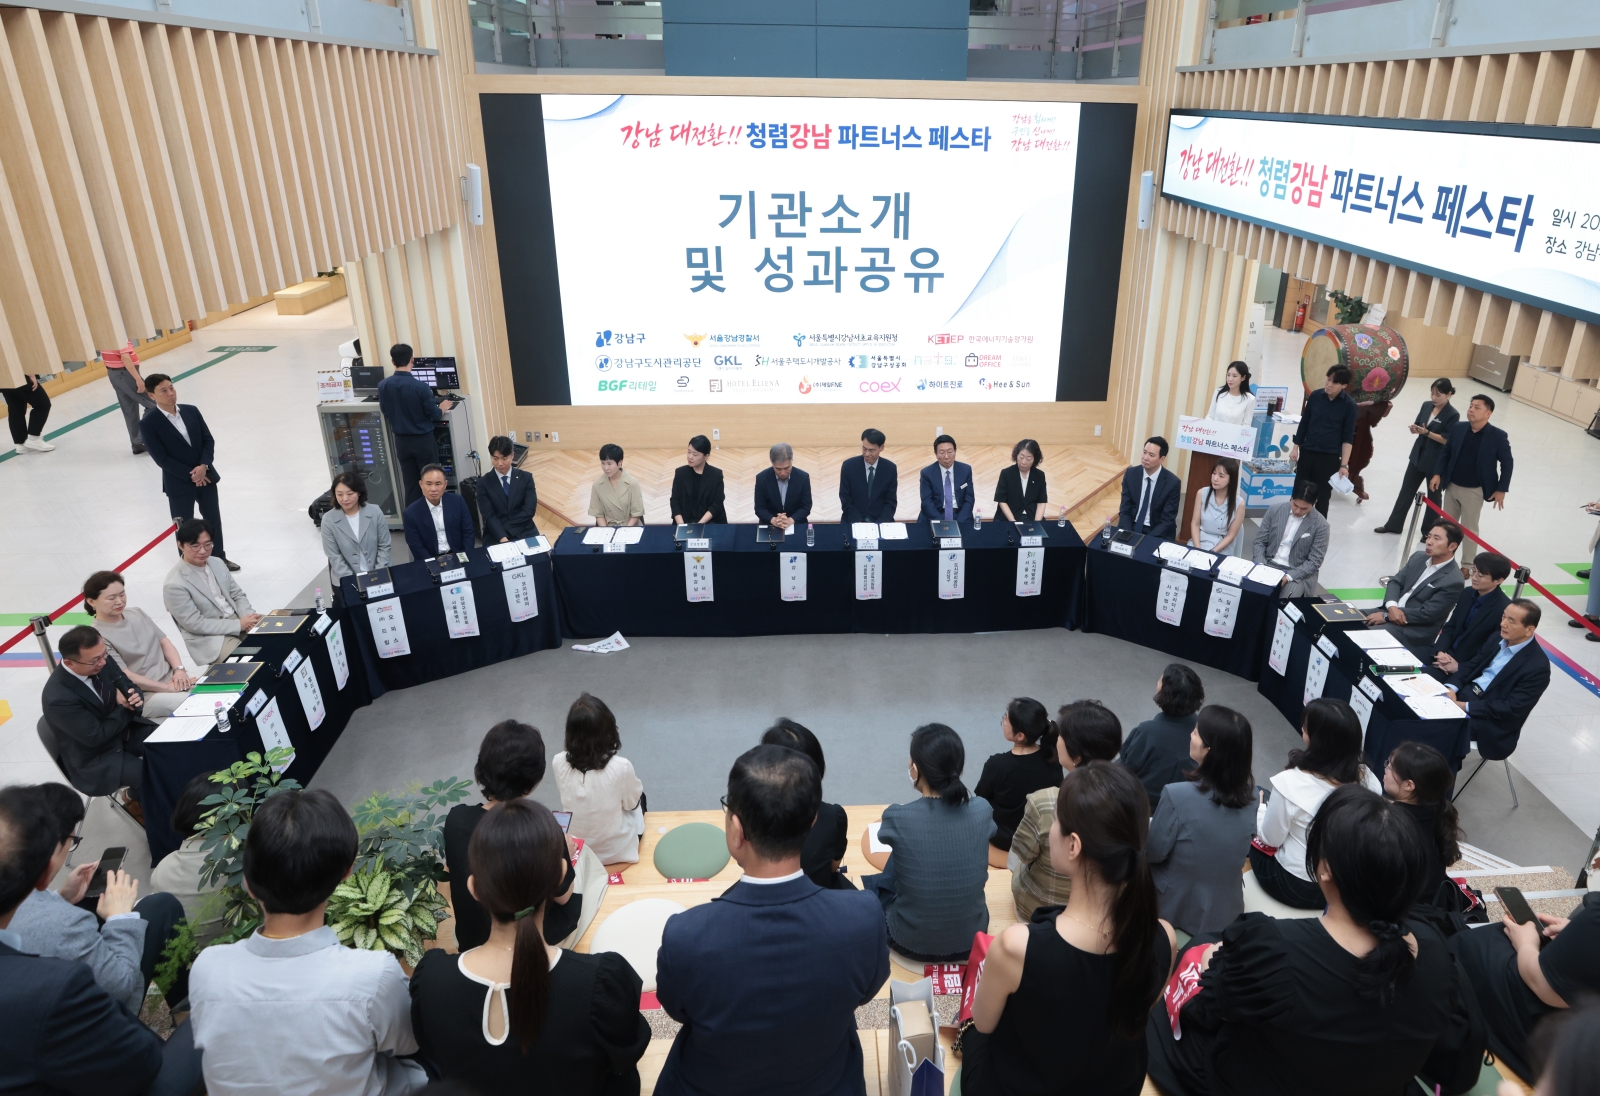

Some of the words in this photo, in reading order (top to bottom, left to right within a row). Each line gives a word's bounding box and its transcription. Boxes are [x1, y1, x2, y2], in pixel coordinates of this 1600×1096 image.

[620, 121, 664, 149] 강남
[669, 119, 742, 147] 대전환!!
[746, 122, 832, 149] 청렴강남
[838, 124, 923, 150] 파트너스
[928, 125, 992, 152] 페스타
[1011, 137, 1032, 152] 강남
[1179, 144, 1204, 182] 강남
[1207, 147, 1255, 188] 대전환!!
[1257, 156, 1328, 209] 청렴강남
[1330, 168, 1424, 224] 파트너스
[1432, 184, 1534, 253] 페스타
[718, 190, 912, 241] 기관소개
[1552, 208, 1577, 229] 일시
[1580, 213, 1600, 231] 20
[1545, 236, 1567, 254] 장소
[1575, 240, 1600, 261] 강남
[686, 246, 727, 293] 및
[753, 246, 945, 293] 성과공유
[614, 332, 647, 344] 강남구
[709, 333, 760, 342] 서울강남경찰서
[927, 333, 965, 346] KETEP
[614, 358, 702, 369] 강남구도시관리공단
[714, 354, 743, 366] GKL
[754, 354, 770, 367] SH
[771, 357, 842, 367] 서울주택도시개발공사
[598, 380, 628, 392] BGF
[628, 380, 657, 392] 리테일
[860, 377, 902, 393] coex
[928, 380, 963, 389] 하이트진로
[993, 380, 1008, 388] Hee
[1008, 380, 1014, 388] &
[1016, 380, 1031, 388] Sun
[1180, 435, 1205, 446] 청렴강남
[1205, 439, 1229, 450] 파트너스
[1230, 444, 1250, 454] 페스타
[262, 706, 275, 724] coex
